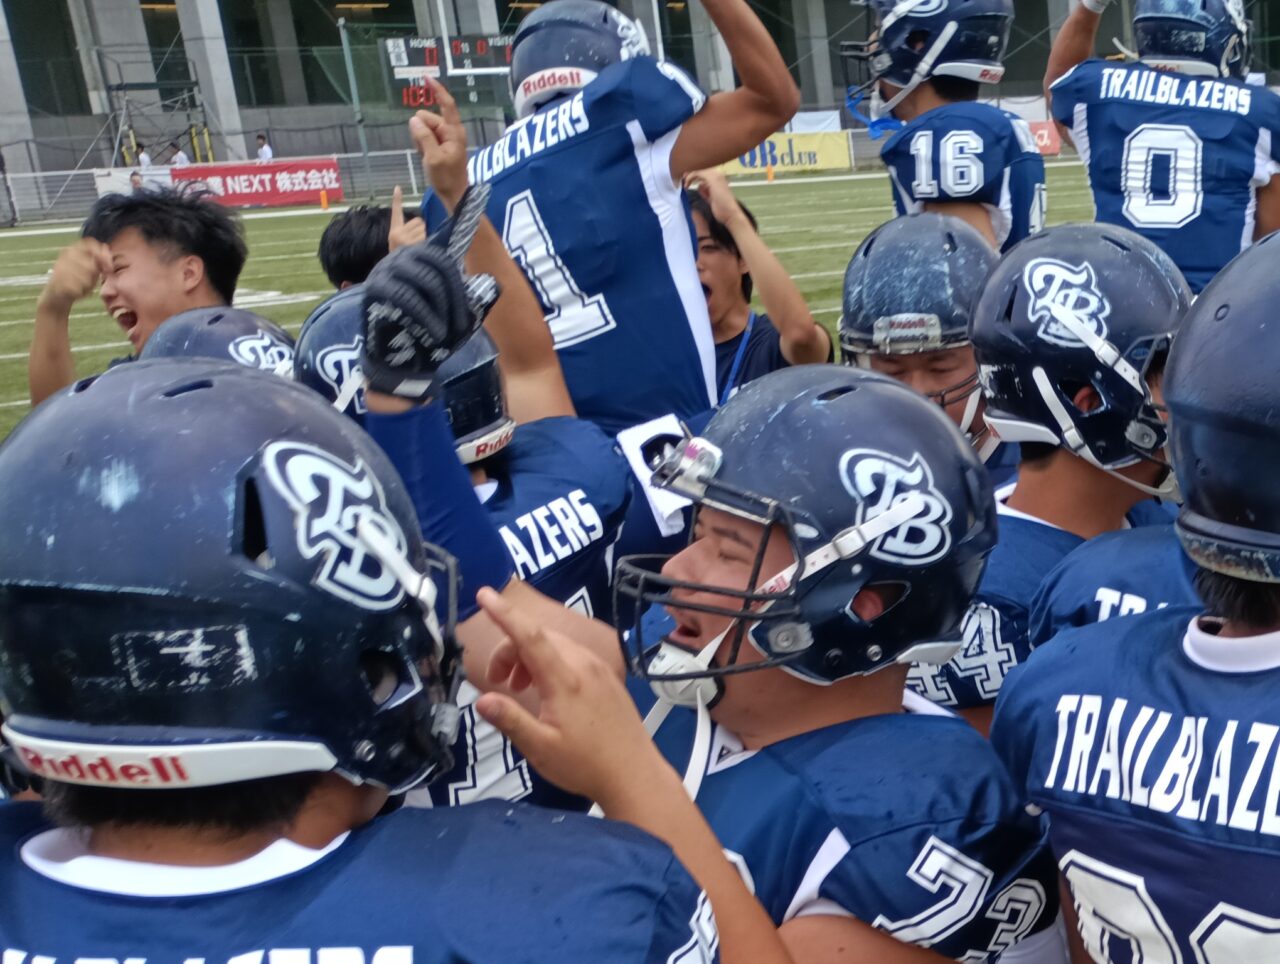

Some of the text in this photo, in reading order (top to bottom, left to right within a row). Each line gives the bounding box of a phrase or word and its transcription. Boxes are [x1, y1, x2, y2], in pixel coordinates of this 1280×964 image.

[523, 69, 581, 98] Riddell
[1100, 67, 1252, 116] TRAILBLAZERS
[226, 173, 272, 195] NEXT
[275, 167, 340, 193] 株式会社
[909, 130, 985, 199] 16
[1120, 123, 1203, 229] 0
[502, 188, 617, 351] 1
[19, 746, 189, 783] Riddell
